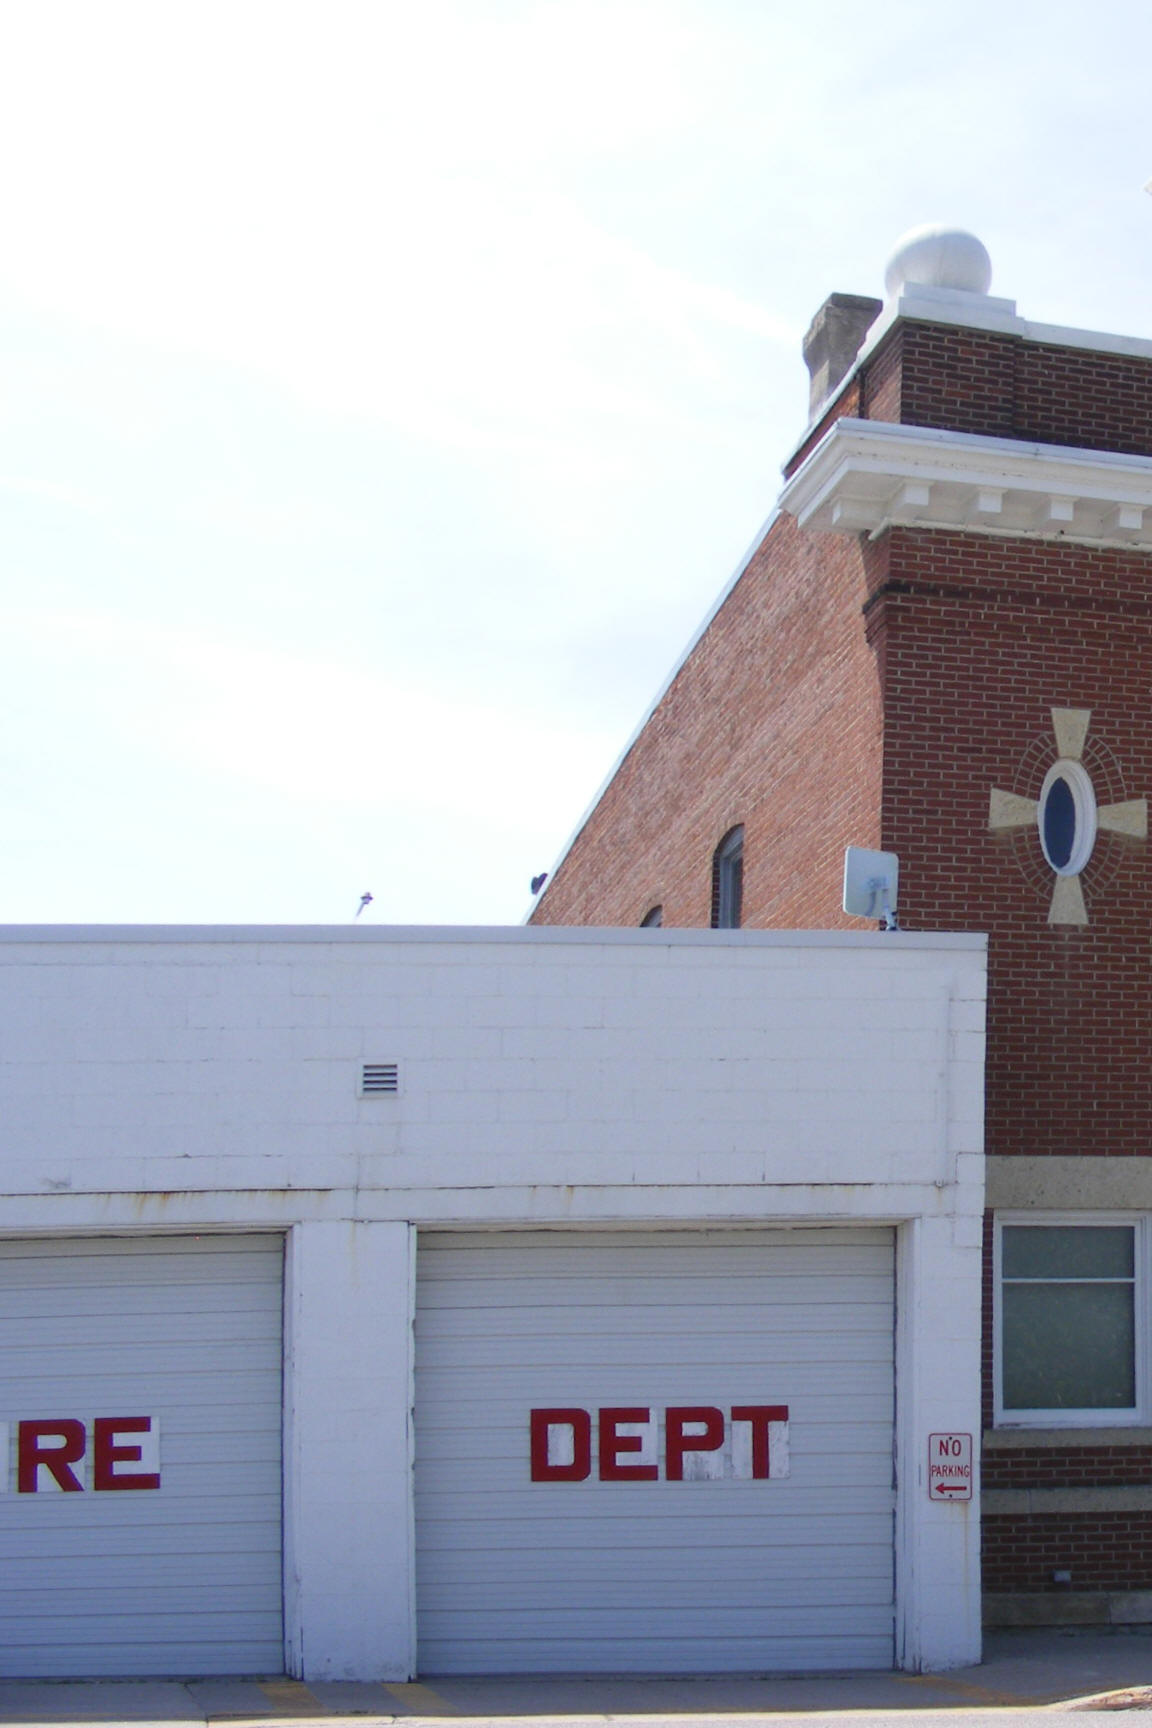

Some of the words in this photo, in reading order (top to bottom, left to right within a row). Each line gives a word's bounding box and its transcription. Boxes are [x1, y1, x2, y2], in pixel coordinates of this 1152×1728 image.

[18, 1416, 161, 1493] RE
[530, 1405, 789, 1482] DEPT
[939, 1439, 962, 1456] NO
[931, 1464, 970, 1478] PARKING
